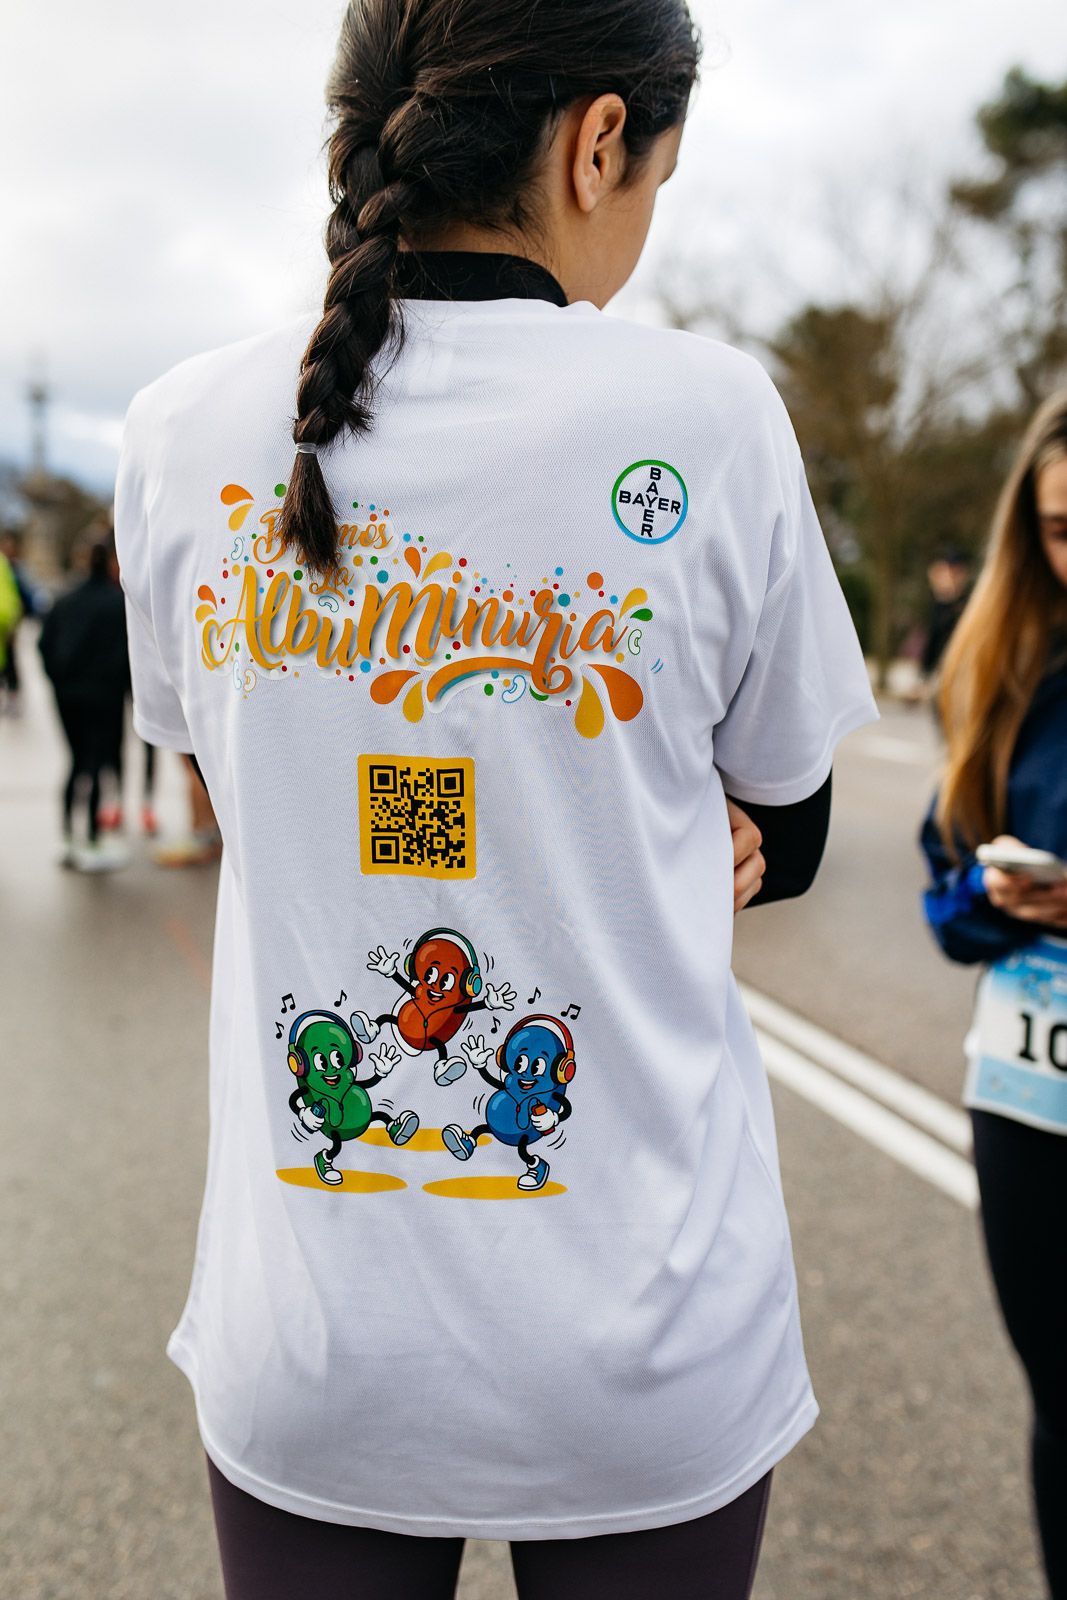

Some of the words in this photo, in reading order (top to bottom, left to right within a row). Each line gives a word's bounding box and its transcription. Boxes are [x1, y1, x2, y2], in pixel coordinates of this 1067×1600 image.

[619, 490, 681, 514] BAYER
[640, 467, 661, 538] BAYER
[201, 565, 628, 702] AlbuMinuria
